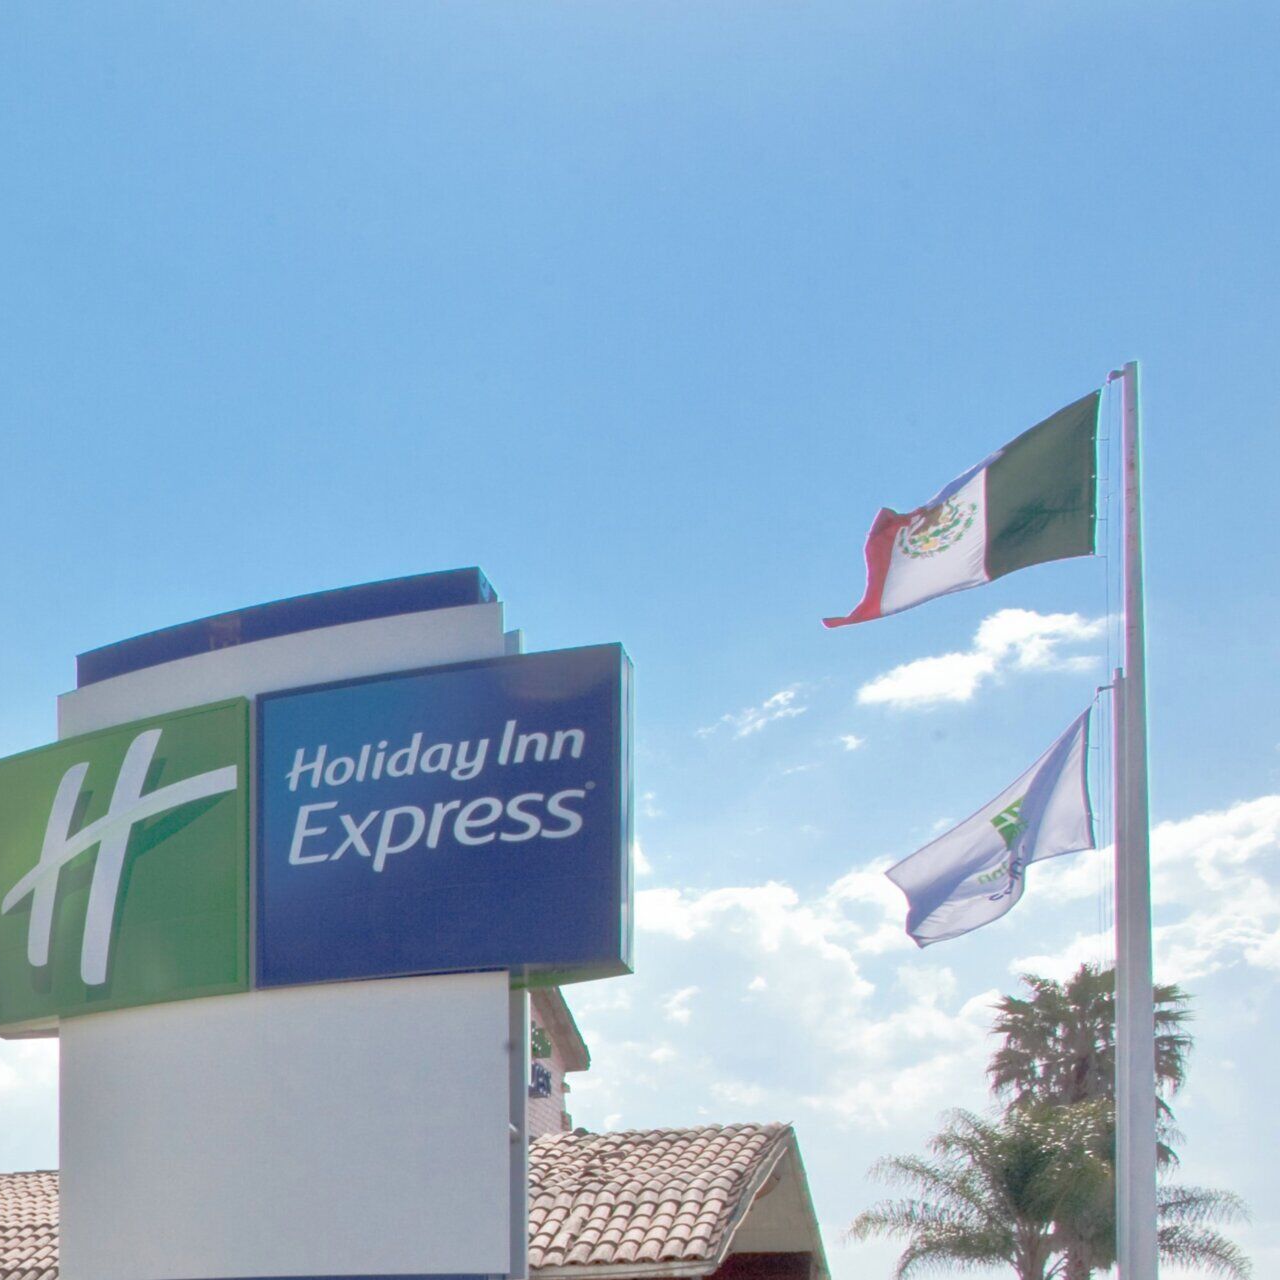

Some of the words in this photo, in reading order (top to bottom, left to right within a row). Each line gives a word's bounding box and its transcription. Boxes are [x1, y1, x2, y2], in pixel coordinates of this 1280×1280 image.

[285, 722, 489, 792] Holiday
[497, 719, 585, 766] Inn
[288, 789, 586, 872] Express
